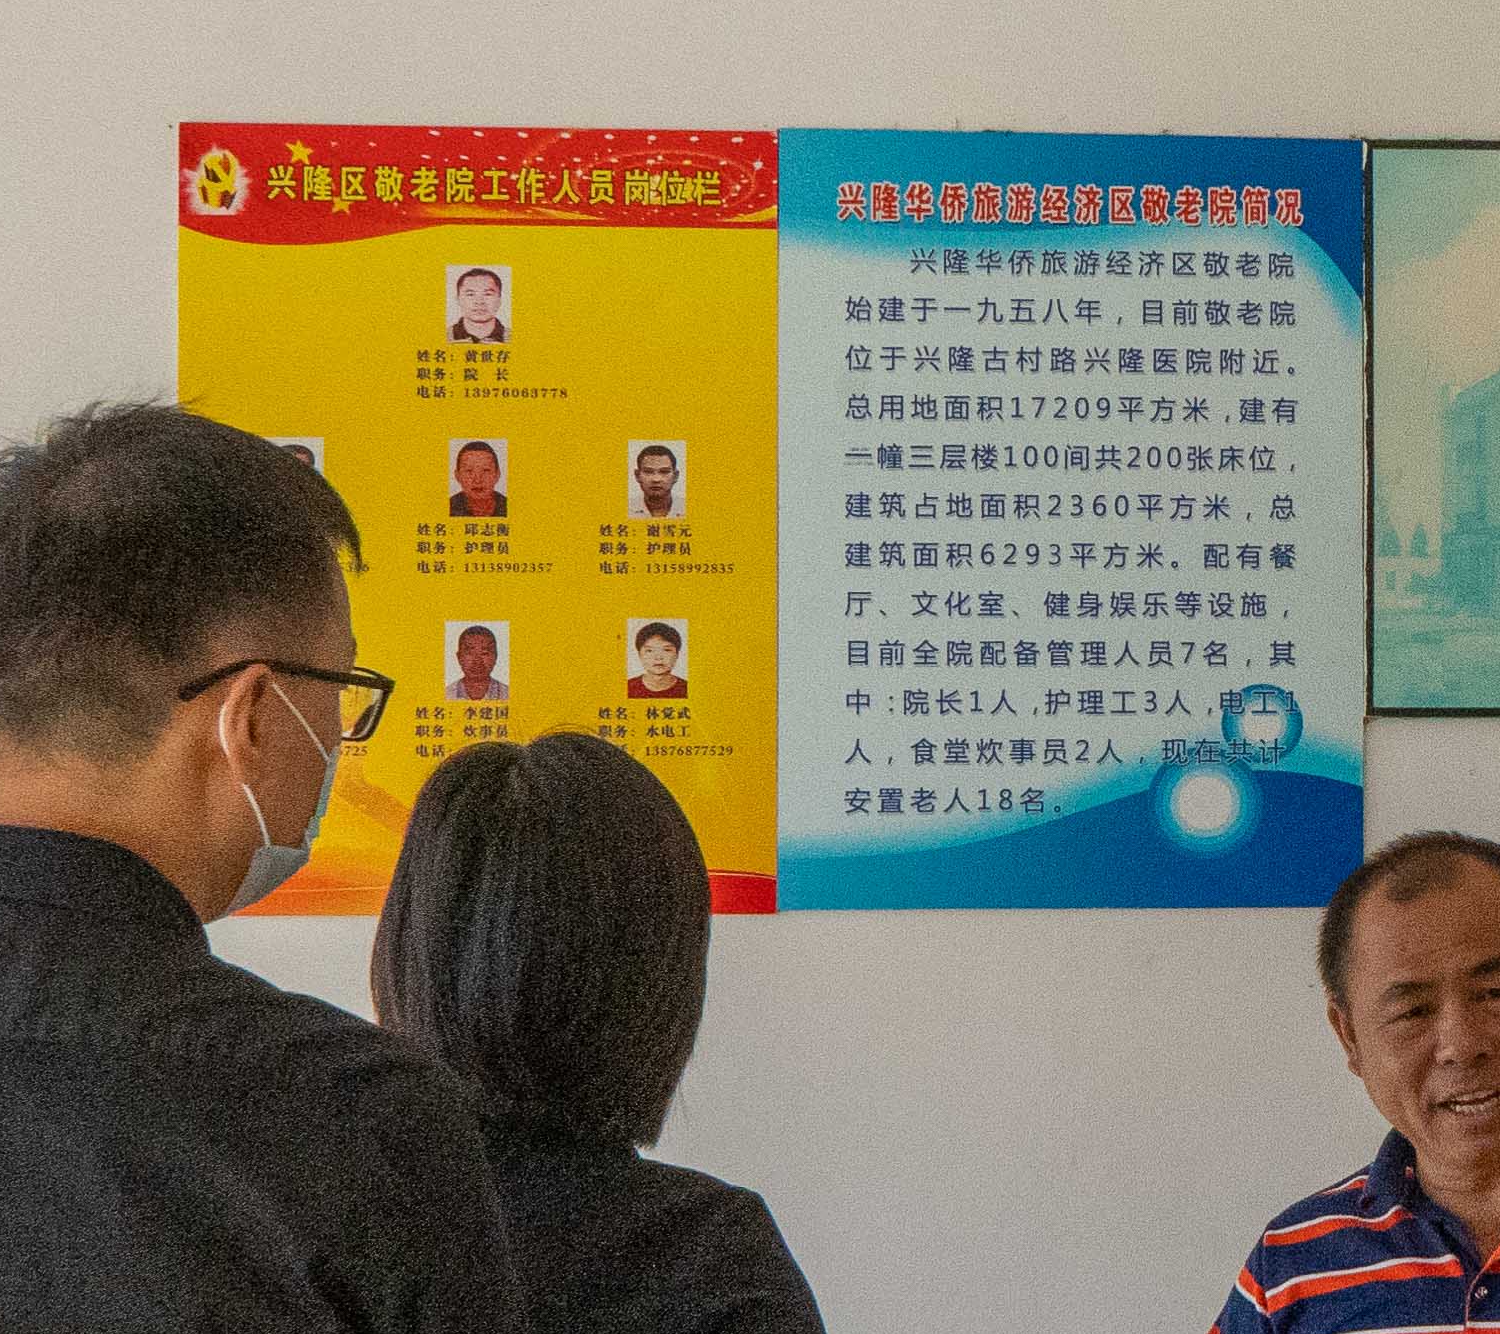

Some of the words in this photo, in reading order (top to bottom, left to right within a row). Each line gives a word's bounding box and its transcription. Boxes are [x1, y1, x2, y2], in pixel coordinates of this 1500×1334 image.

[266, 164, 722, 207] 兴隆区敬老院工作人员岗位栏
[837, 182, 1304, 226] 兴隆华侨旅游经济区敬老院简况
[910, 249, 1295, 278] 兴隆华侨旅游经济区敬老院
[845, 296, 1297, 327] 始建于一九五八年，目前敬老院
[845, 345, 1297, 375] 位于兴隆古村路兴隆医院附近。
[845, 493, 1297, 521] 建筑占地面积2360平方米，总
[845, 542, 1297, 571] 建筑面积6293平方米。配有餐
[844, 591, 1291, 620] 厅、文化室、健身娱乐等设施，
[846, 640, 1296, 668] 目前全院配备管理人员7名，其
[845, 738, 1284, 766] 人，食堂炊事员2人，现在共计
[844, 787, 1066, 815] 安置老人18名。
